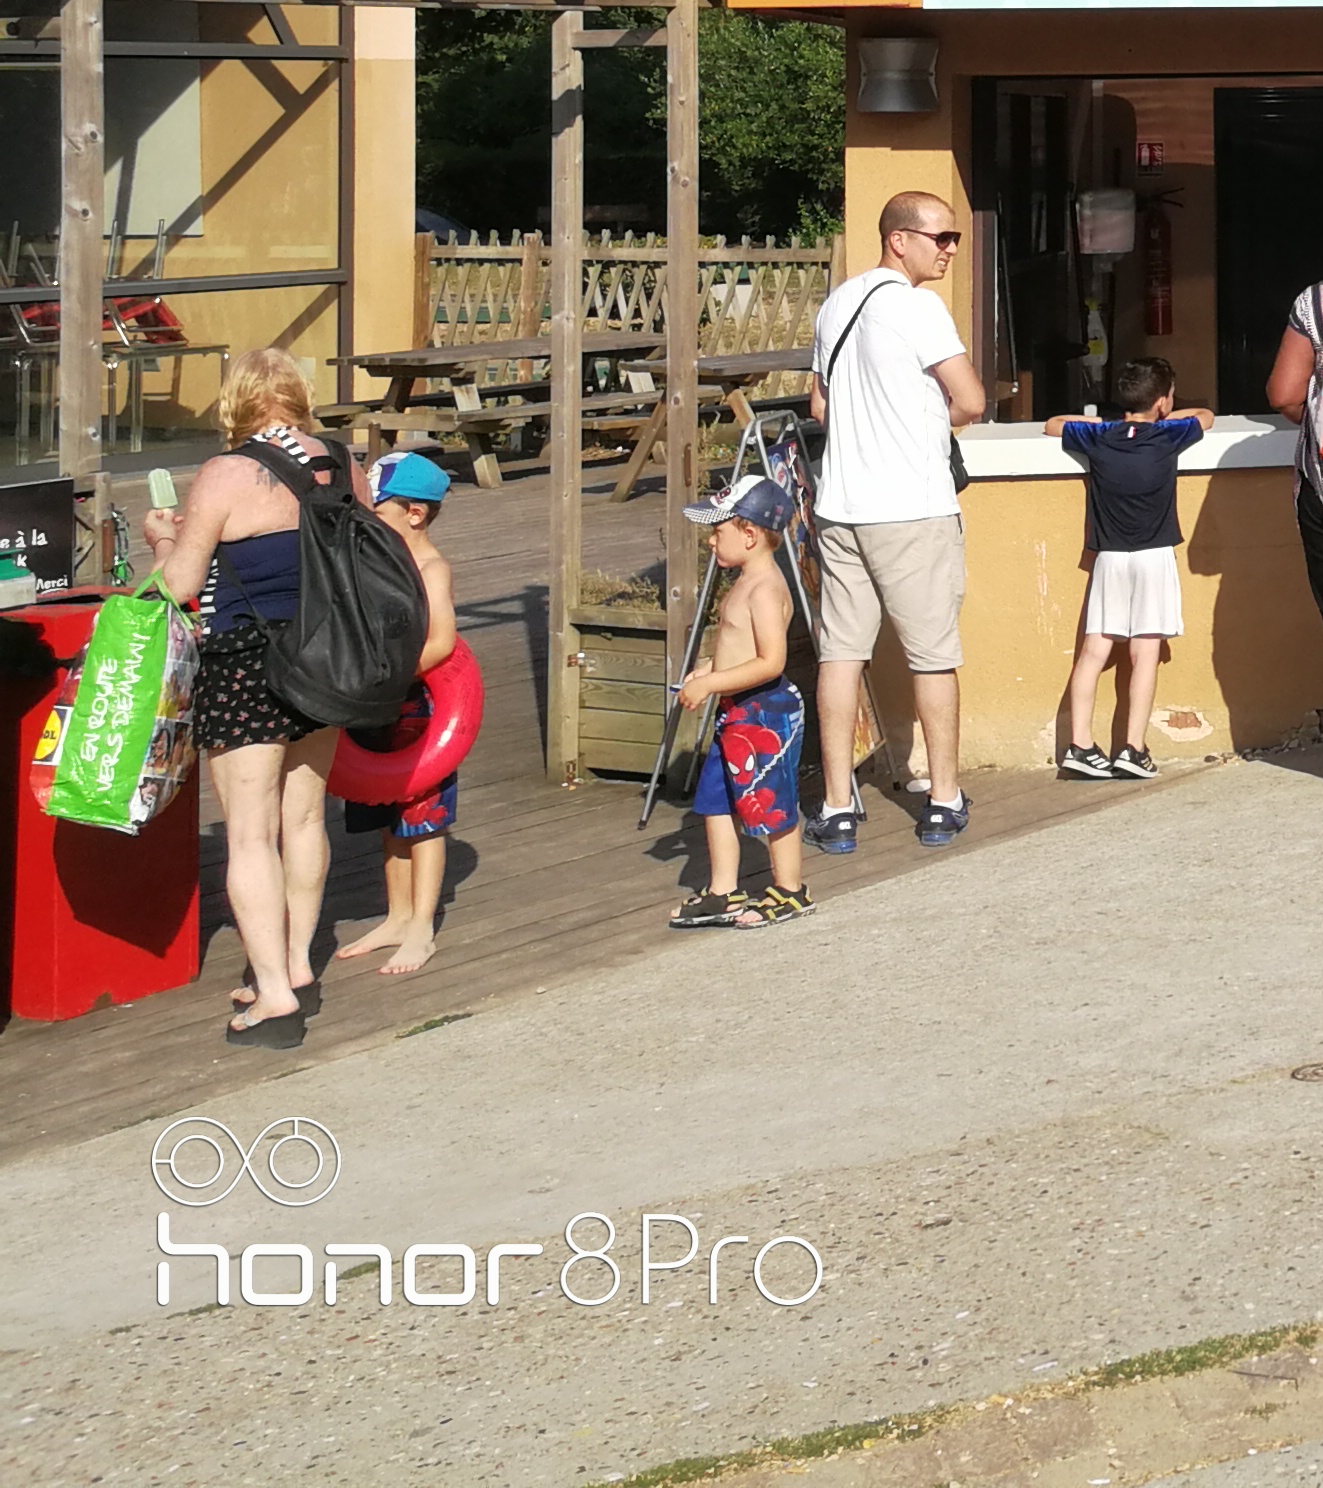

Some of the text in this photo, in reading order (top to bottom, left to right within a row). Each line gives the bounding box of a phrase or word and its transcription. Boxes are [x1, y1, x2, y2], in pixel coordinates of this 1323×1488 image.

[31, 528, 48, 546] la
[80, 657, 117, 761] EN ROUTE
[95, 733, 123, 792] VERS
